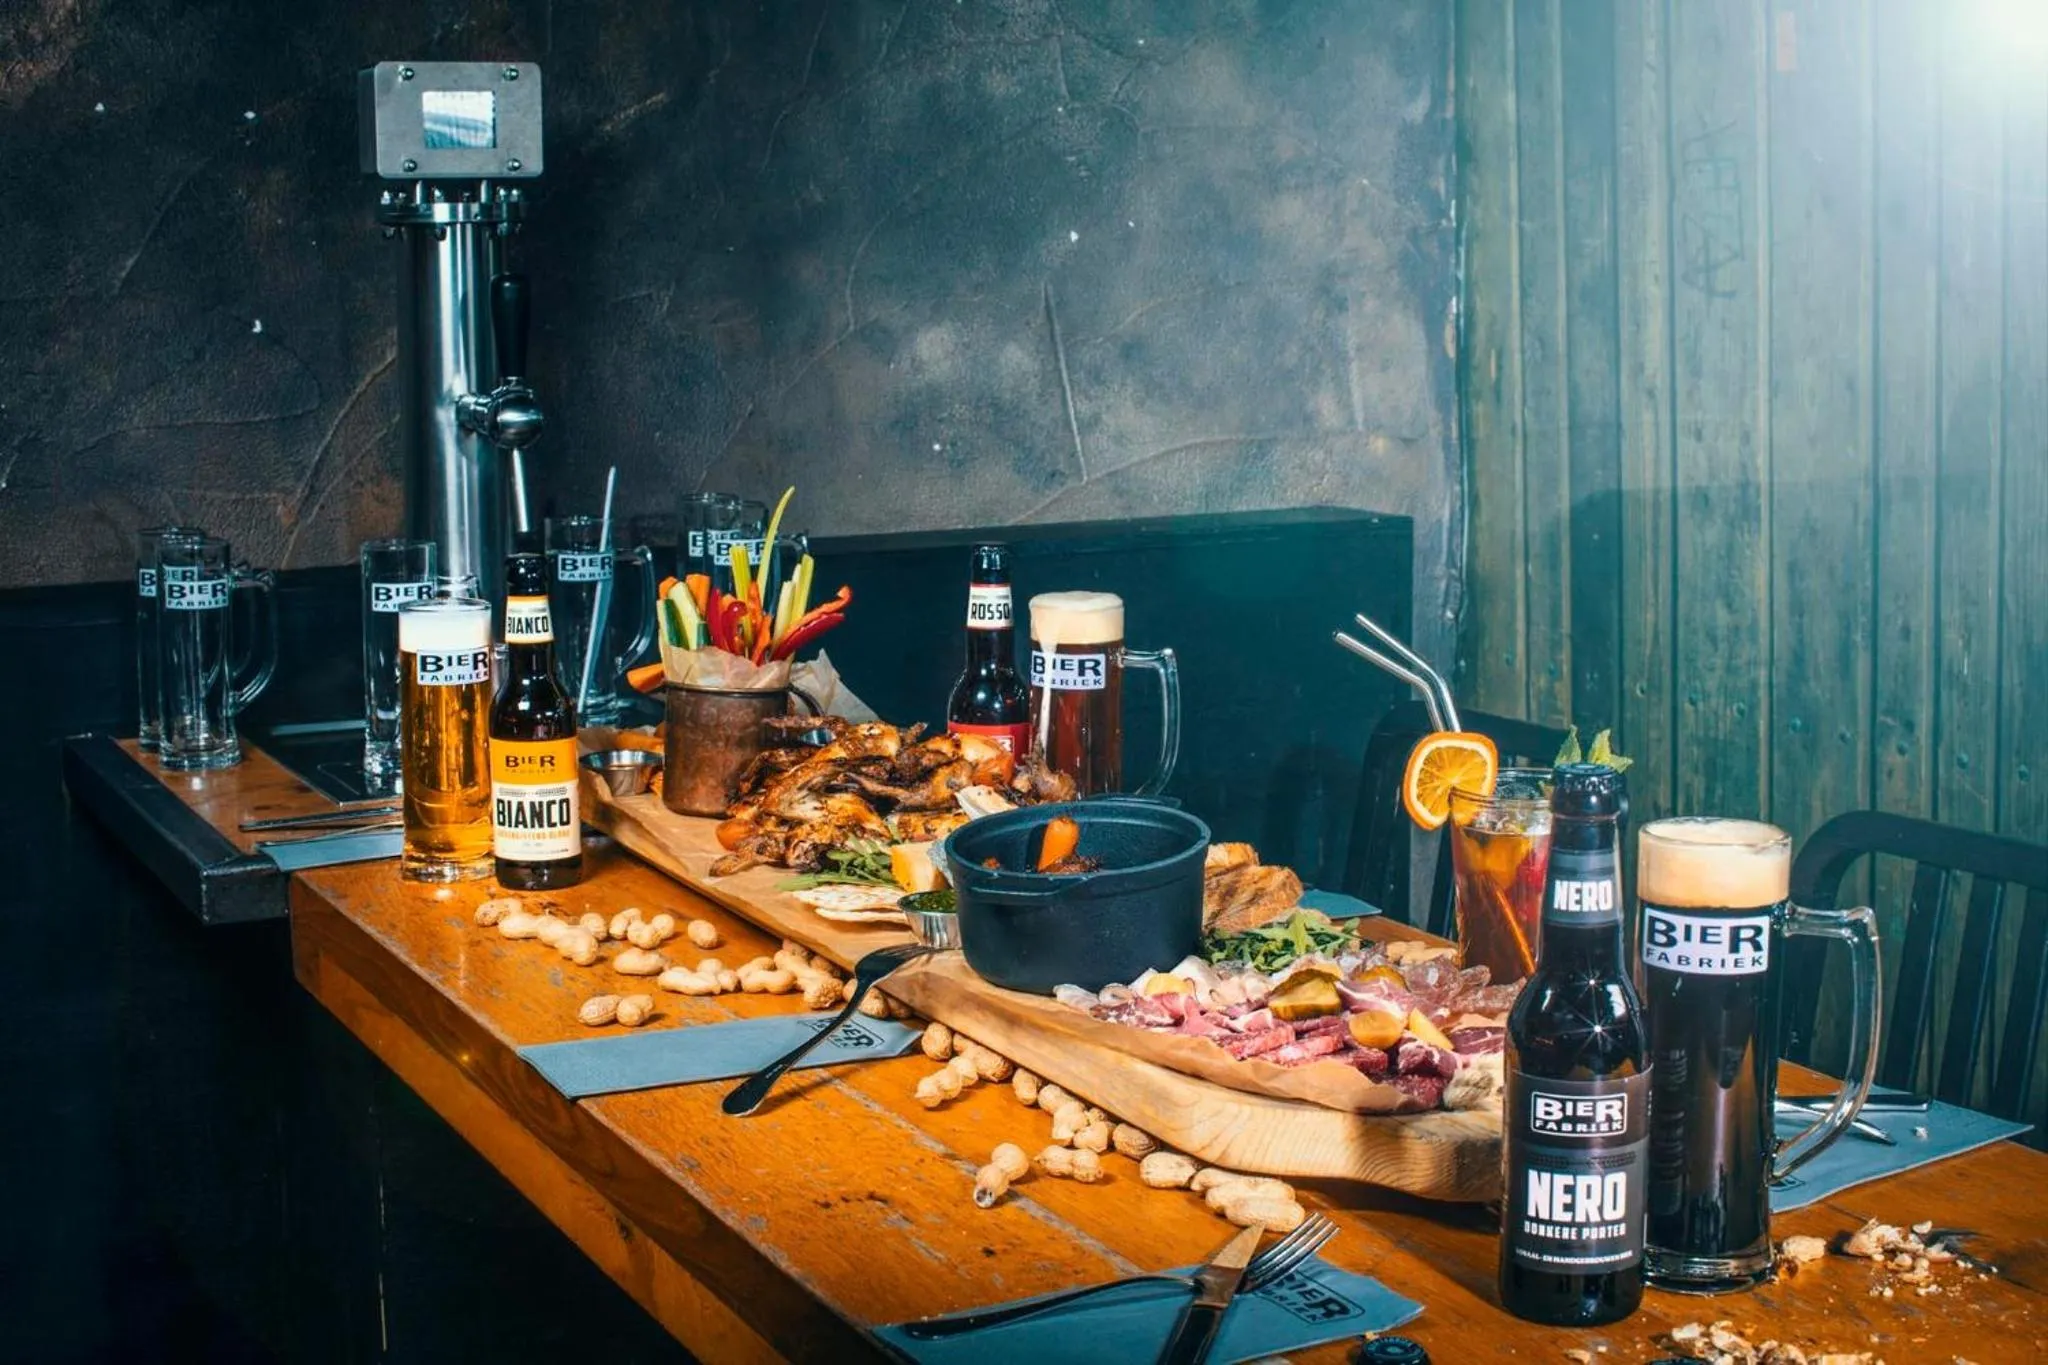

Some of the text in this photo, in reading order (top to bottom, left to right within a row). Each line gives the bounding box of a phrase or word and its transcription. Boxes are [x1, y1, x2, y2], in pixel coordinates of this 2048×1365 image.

[560, 556, 613, 572] BIER
[167, 582, 228, 599] BIER
[374, 585, 433, 602] BIER
[970, 602, 1010, 620] ROSSO
[507, 615, 550, 635] BIANCO
[420, 651, 489, 673] BIER
[1033, 655, 1102, 677] BIER
[505, 755, 556, 768] BIER
[496, 797, 571, 829] BIANCO
[1553, 879, 1614, 913] NERO
[1647, 914, 1764, 954] BIER
[1645, 947, 1764, 969] FABRIEK
[1535, 1096, 1624, 1123] BIER
[1535, 1119, 1623, 1133] FABRIEK
[1527, 1168, 1627, 1223] NERO
[1581, 1222, 1627, 1240] PORTER
